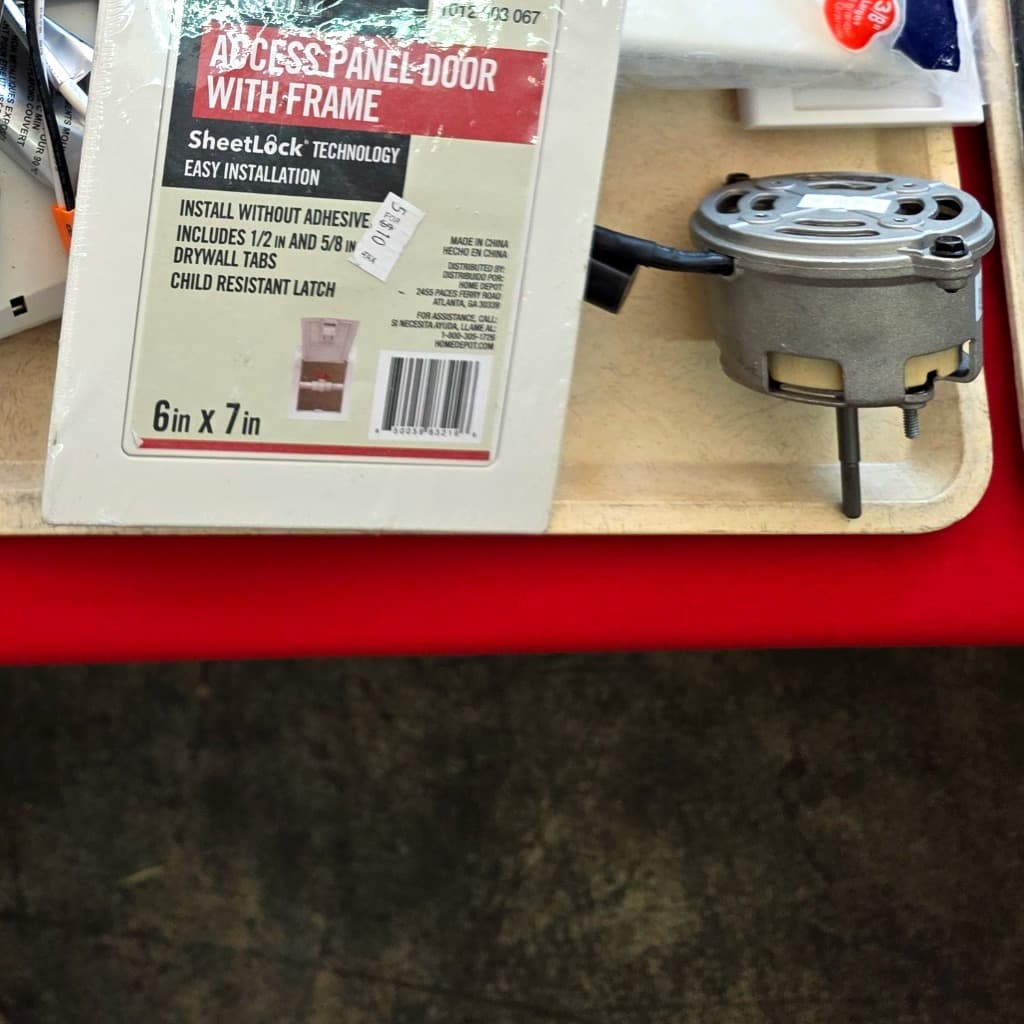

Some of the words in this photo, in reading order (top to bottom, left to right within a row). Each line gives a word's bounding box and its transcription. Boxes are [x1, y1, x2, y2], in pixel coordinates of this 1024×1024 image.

[513, 9, 542, 25] 067
[209, 34, 329, 77] ACCESS
[329, 46, 413, 85] PANEL
[421, 53, 498, 92] DOOR
[207, 75, 278, 115] WITH
[286, 82, 382, 123] FRAME
[16, 102, 34, 147] COUVERT
[188, 130, 305, 158] SheetLock
[312, 140, 401, 165] TECHNOLOGY
[184, 160, 221, 179] EASY
[225, 162, 320, 186] INSTALLATION
[180, 199, 235, 220] INSTALL
[239, 203, 302, 225] WITHOUT
[176, 224, 246, 246] INCLUDES
[251, 230, 272, 248] 1/2
[275, 235, 286, 249] IN
[289, 232, 317, 250] AND
[320, 234, 342, 252] 5/8
[450, 236, 473, 247] MADE
[475, 237, 483, 246] IN
[484, 238, 509, 248] CHINA
[174, 246, 239, 268] DRYWALL
[243, 251, 277, 269] TABS
[442, 246, 469, 256] HECHO
[471, 247, 481, 257] EN
[483, 248, 508, 258] CHINA
[448, 262, 493, 272] DISTRIBUTED
[170, 272, 213, 291] CHILD
[216, 274, 291, 296] RESISTANT
[293, 279, 336, 298] LATCH
[435, 289, 457, 297] PACES
[459, 290, 480, 299] FERRY
[481, 291, 501, 300] ROAD
[459, 281, 478, 289] HOME
[480, 283, 503, 291] DEPOT
[416, 311, 431, 319] FOR
[153, 399, 191, 434] 6in
[225, 402, 261, 436] 7in
